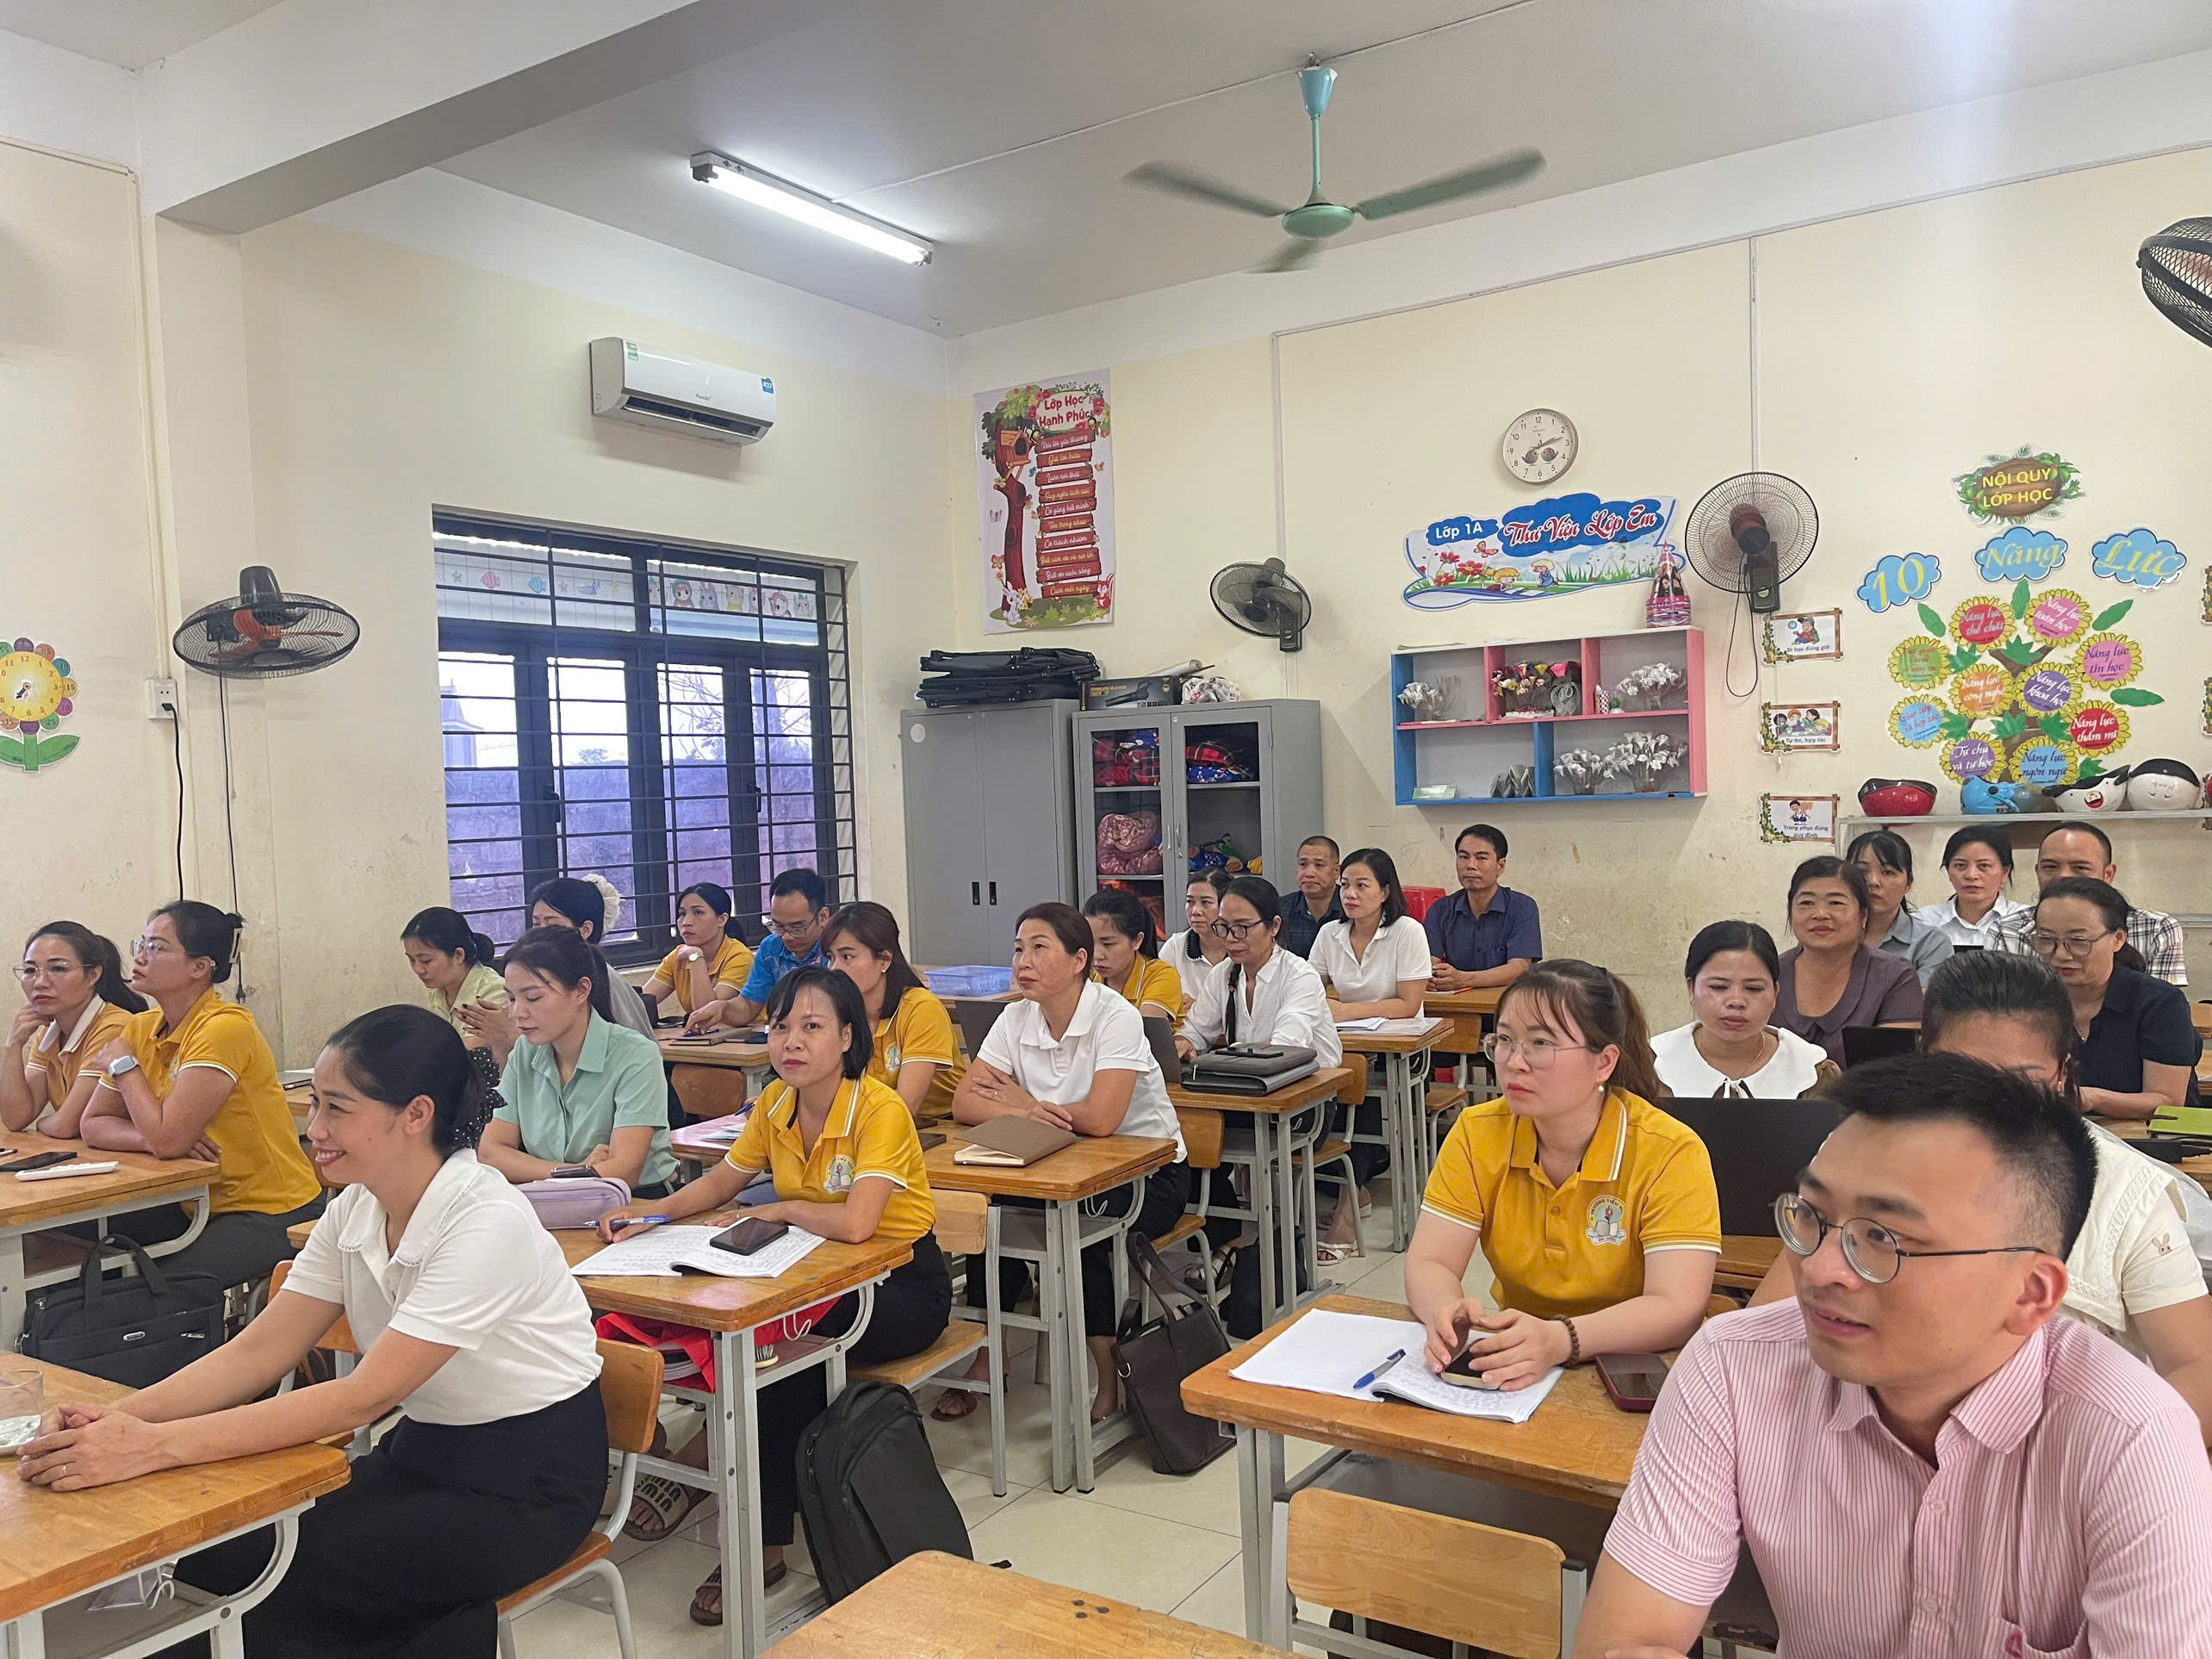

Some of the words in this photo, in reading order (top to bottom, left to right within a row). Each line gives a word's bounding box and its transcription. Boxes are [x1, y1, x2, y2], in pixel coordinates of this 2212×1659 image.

[1045, 399, 1062, 411] Lớp
[1065, 395, 1084, 408] Học
[1039, 413, 1064, 428] Hạnh
[1066, 408, 1090, 423] Phúc
[1983, 471, 2012, 488] NỘI
[2016, 468, 2052, 484] QUY
[1983, 492, 2013, 508] LỚP
[2018, 488, 2053, 505] HỌC
[1436, 525, 1460, 540] Lớp
[1465, 521, 1483, 536] 1A
[1504, 520, 1542, 546] Thư
[1544, 513, 1580, 542] Viện
[1585, 509, 1622, 540] Lớp
[1625, 505, 1657, 533] Em
[1873, 557, 1925, 608] 10
[1985, 542, 2060, 568] Năng
[2095, 539, 2178, 579] Lực
